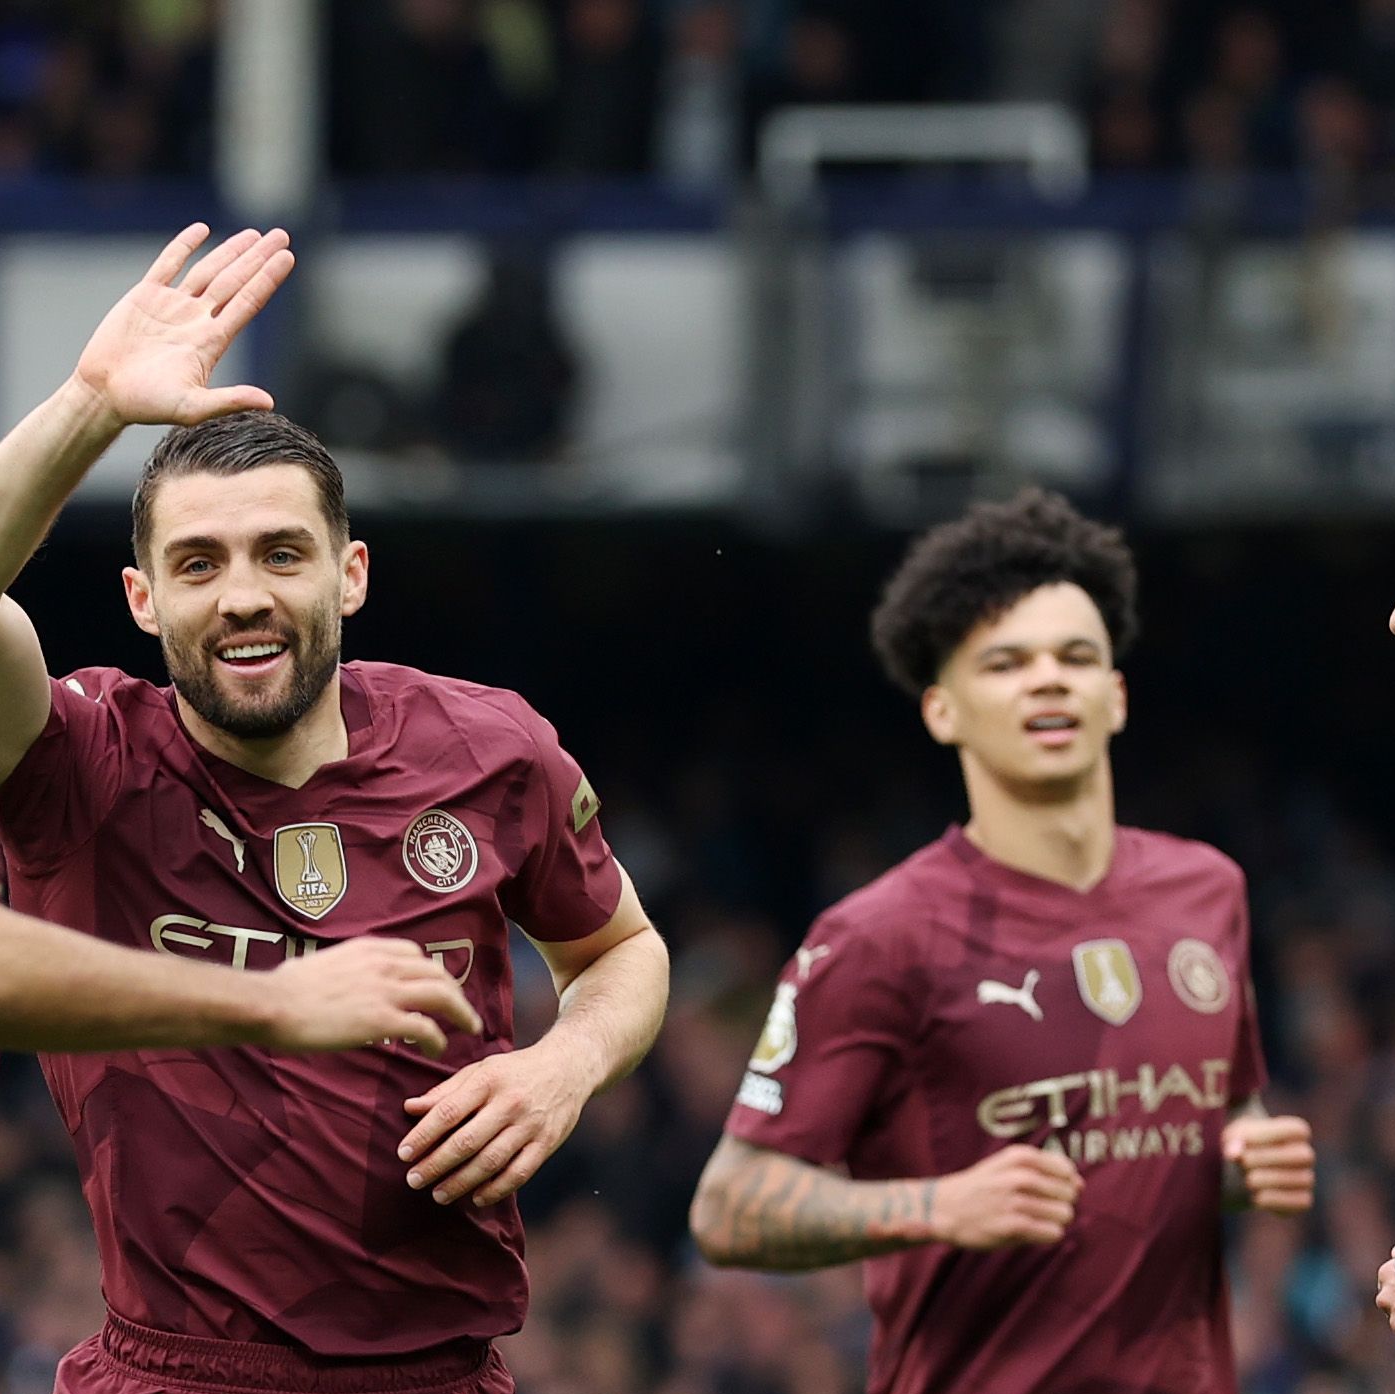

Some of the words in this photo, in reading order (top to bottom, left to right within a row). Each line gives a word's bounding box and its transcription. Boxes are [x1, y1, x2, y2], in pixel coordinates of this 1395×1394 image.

[409, 815, 463, 845] MANCHESTER
[297, 882, 330, 896] FIFA
[436, 875, 458, 887] CITY
[1039, 1120, 1206, 1165] AIRWAYS
